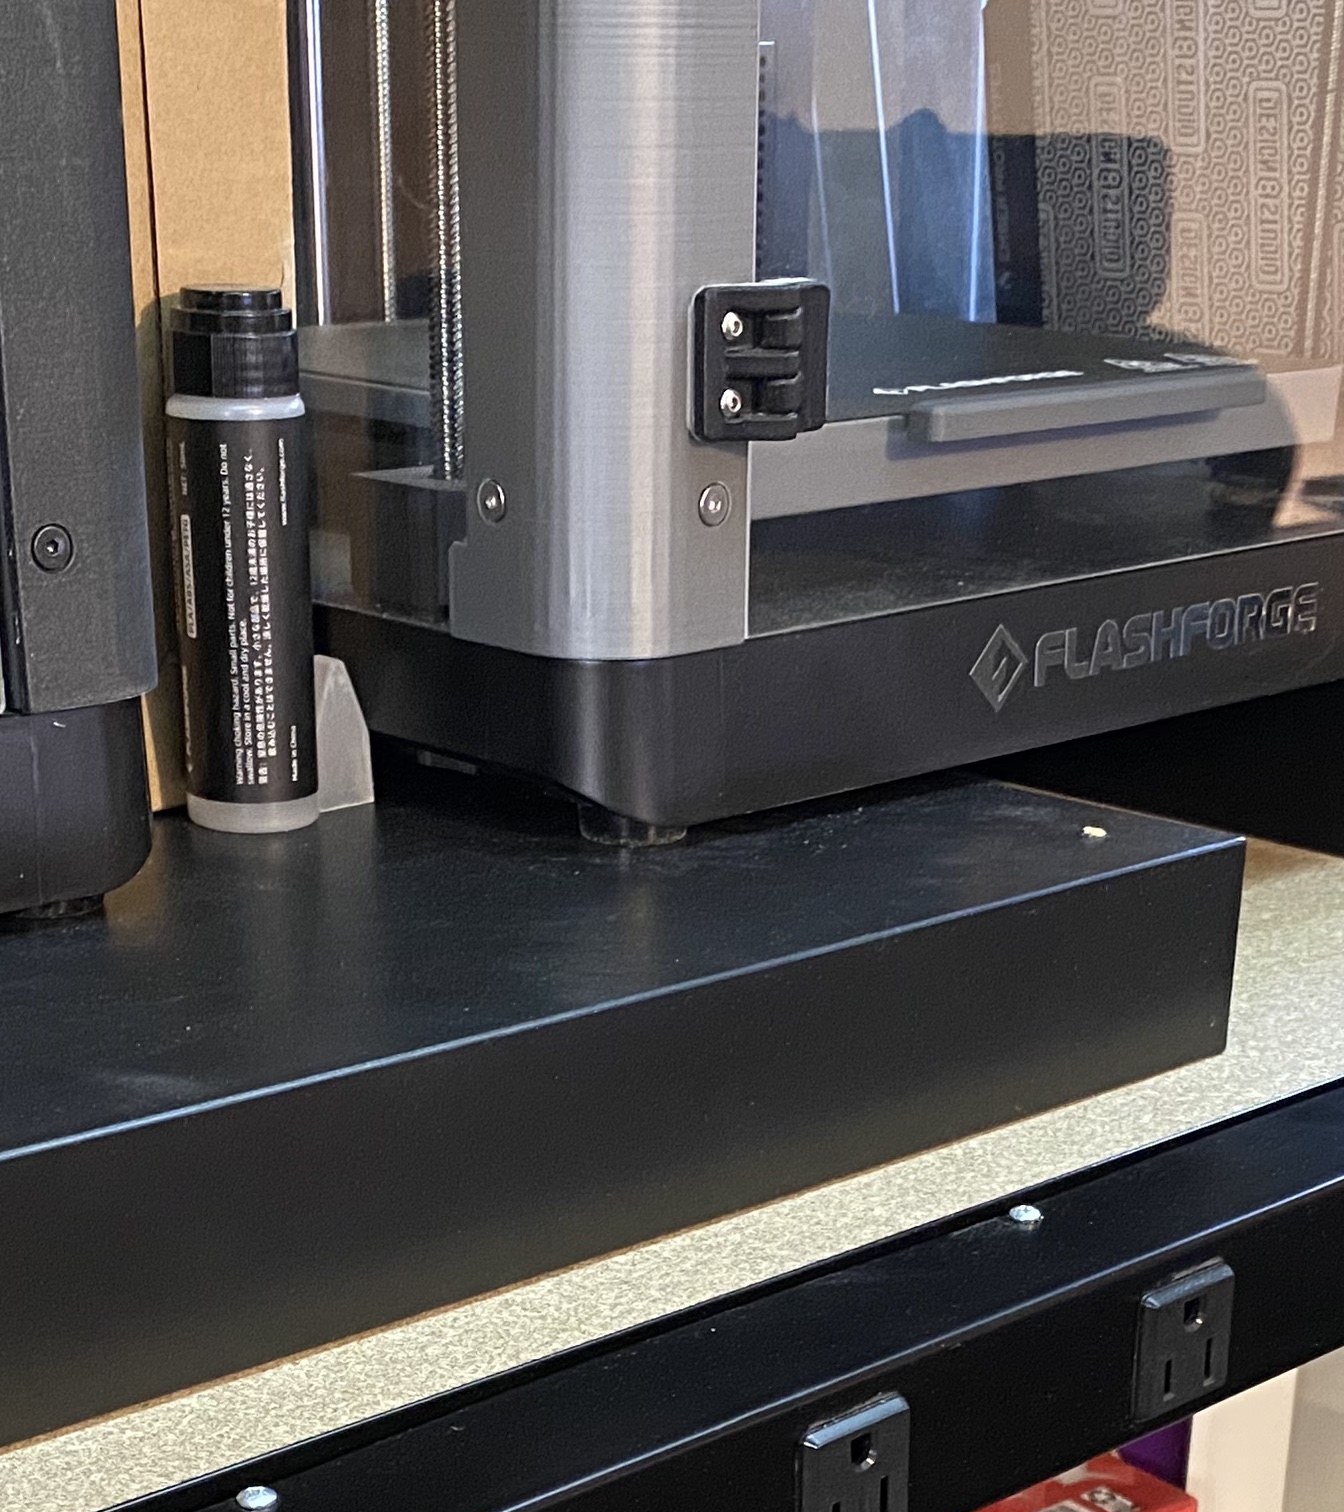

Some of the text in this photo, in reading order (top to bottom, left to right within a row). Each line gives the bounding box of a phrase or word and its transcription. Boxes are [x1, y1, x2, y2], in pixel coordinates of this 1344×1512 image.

[218, 443, 228, 460] not
[219, 461, 229, 476] Do
[221, 478, 232, 506] years.
[221, 507, 230, 518] 12
[222, 520, 232, 548] under
[224, 550, 234, 587] children
[225, 588, 234, 602] for
[227, 603, 236, 620] Not
[226, 621, 238, 648] parts.
[238, 618, 249, 646] place.
[1033, 580, 1322, 690] FLASHFORGE
[228, 649, 238, 675] Small
[239, 647, 251, 662] dry
[240, 664, 250, 682] and
[241, 684, 251, 703] cool
[242, 711, 251, 722] in
[232, 711, 243, 747] choking
[243, 722, 253, 746] Store
[289, 725, 298, 748] China
[234, 749, 245, 785] Warning
